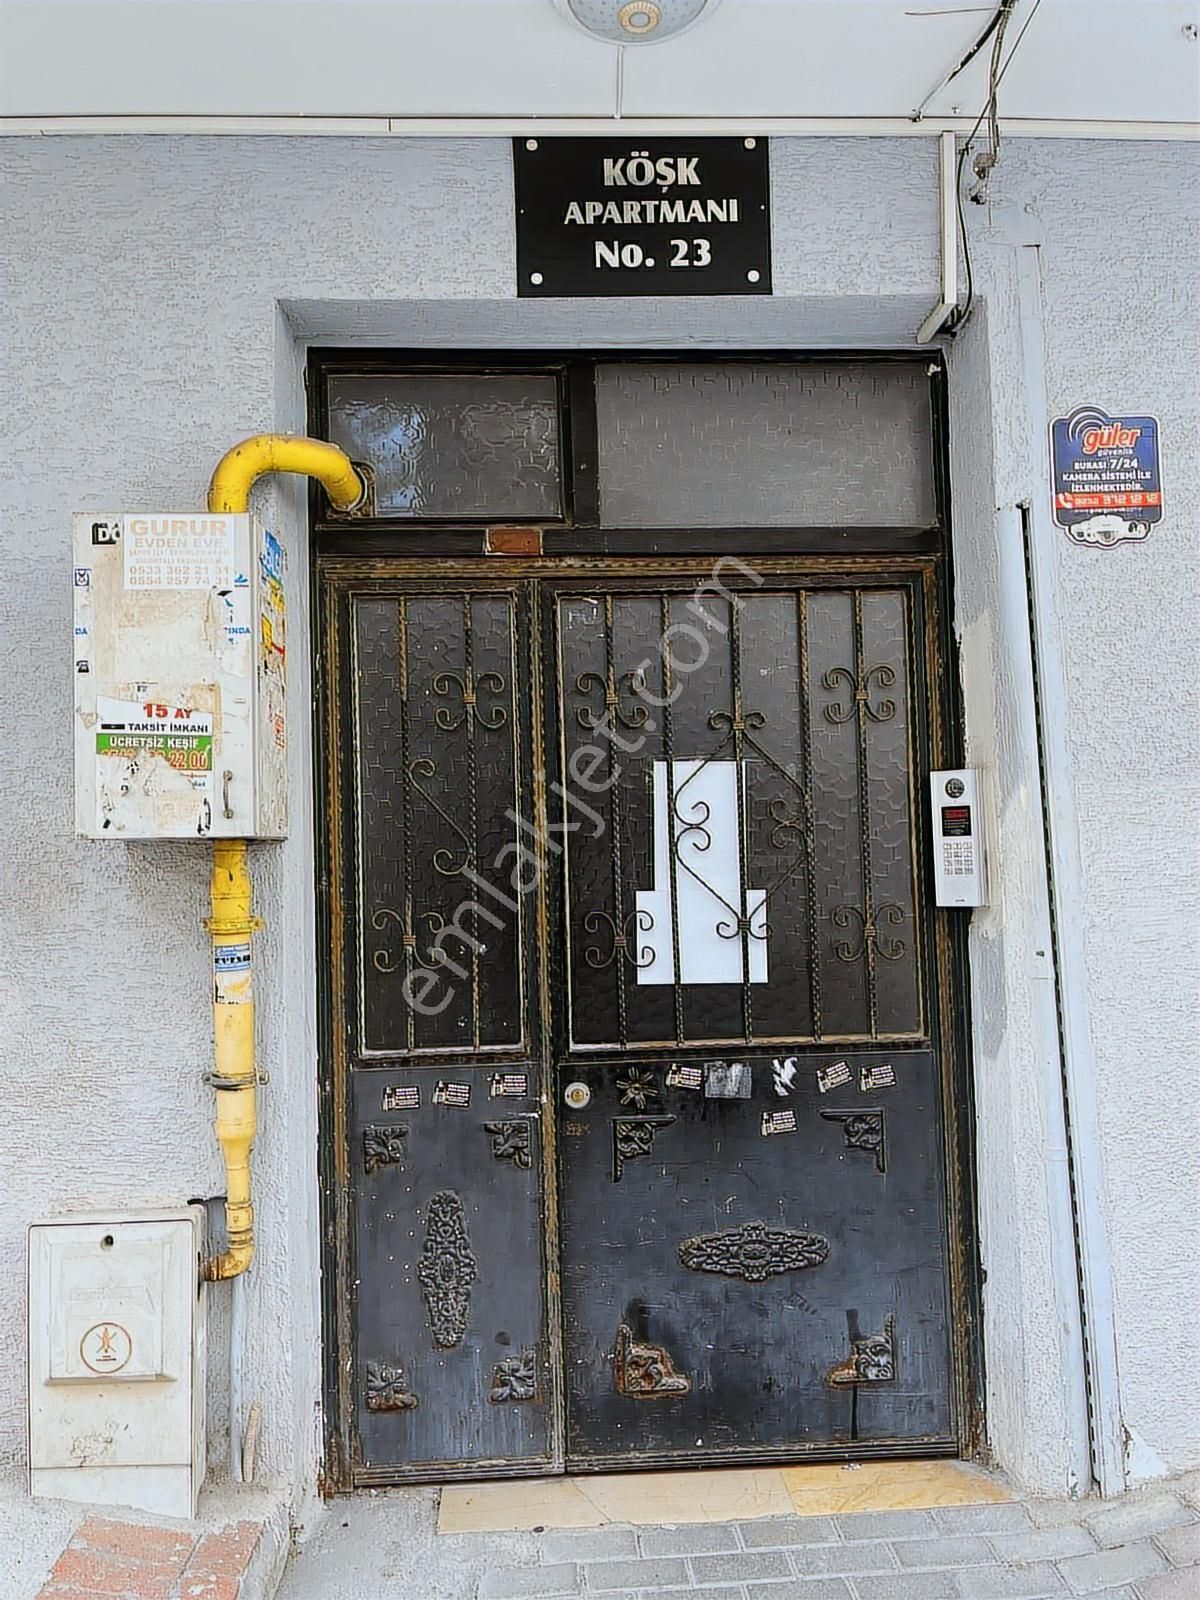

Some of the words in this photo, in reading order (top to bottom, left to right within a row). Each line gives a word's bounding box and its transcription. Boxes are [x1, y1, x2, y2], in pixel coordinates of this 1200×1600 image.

[603, 151, 701, 193] KÖŞK
[564, 199, 738, 225] APARTMANI
[595, 241, 655, 268] No.
[670, 239, 712, 267] 23
[1083, 422, 1140, 455] güler
[1109, 458, 1138, 470] 7/24
[1062, 472, 1100, 481] KAMERA
[130, 519, 227, 537] GURUR
[134, 537, 187, 548] EVDEN
[193, 537, 224, 548] EVE
[143, 703, 169, 718] 15
[174, 708, 192, 719] AY
[127, 722, 167, 732] TAKSİT
[170, 722, 209, 733] İMKANI
[169, 750, 187, 769] 22
[190, 751, 208, 770] 00
